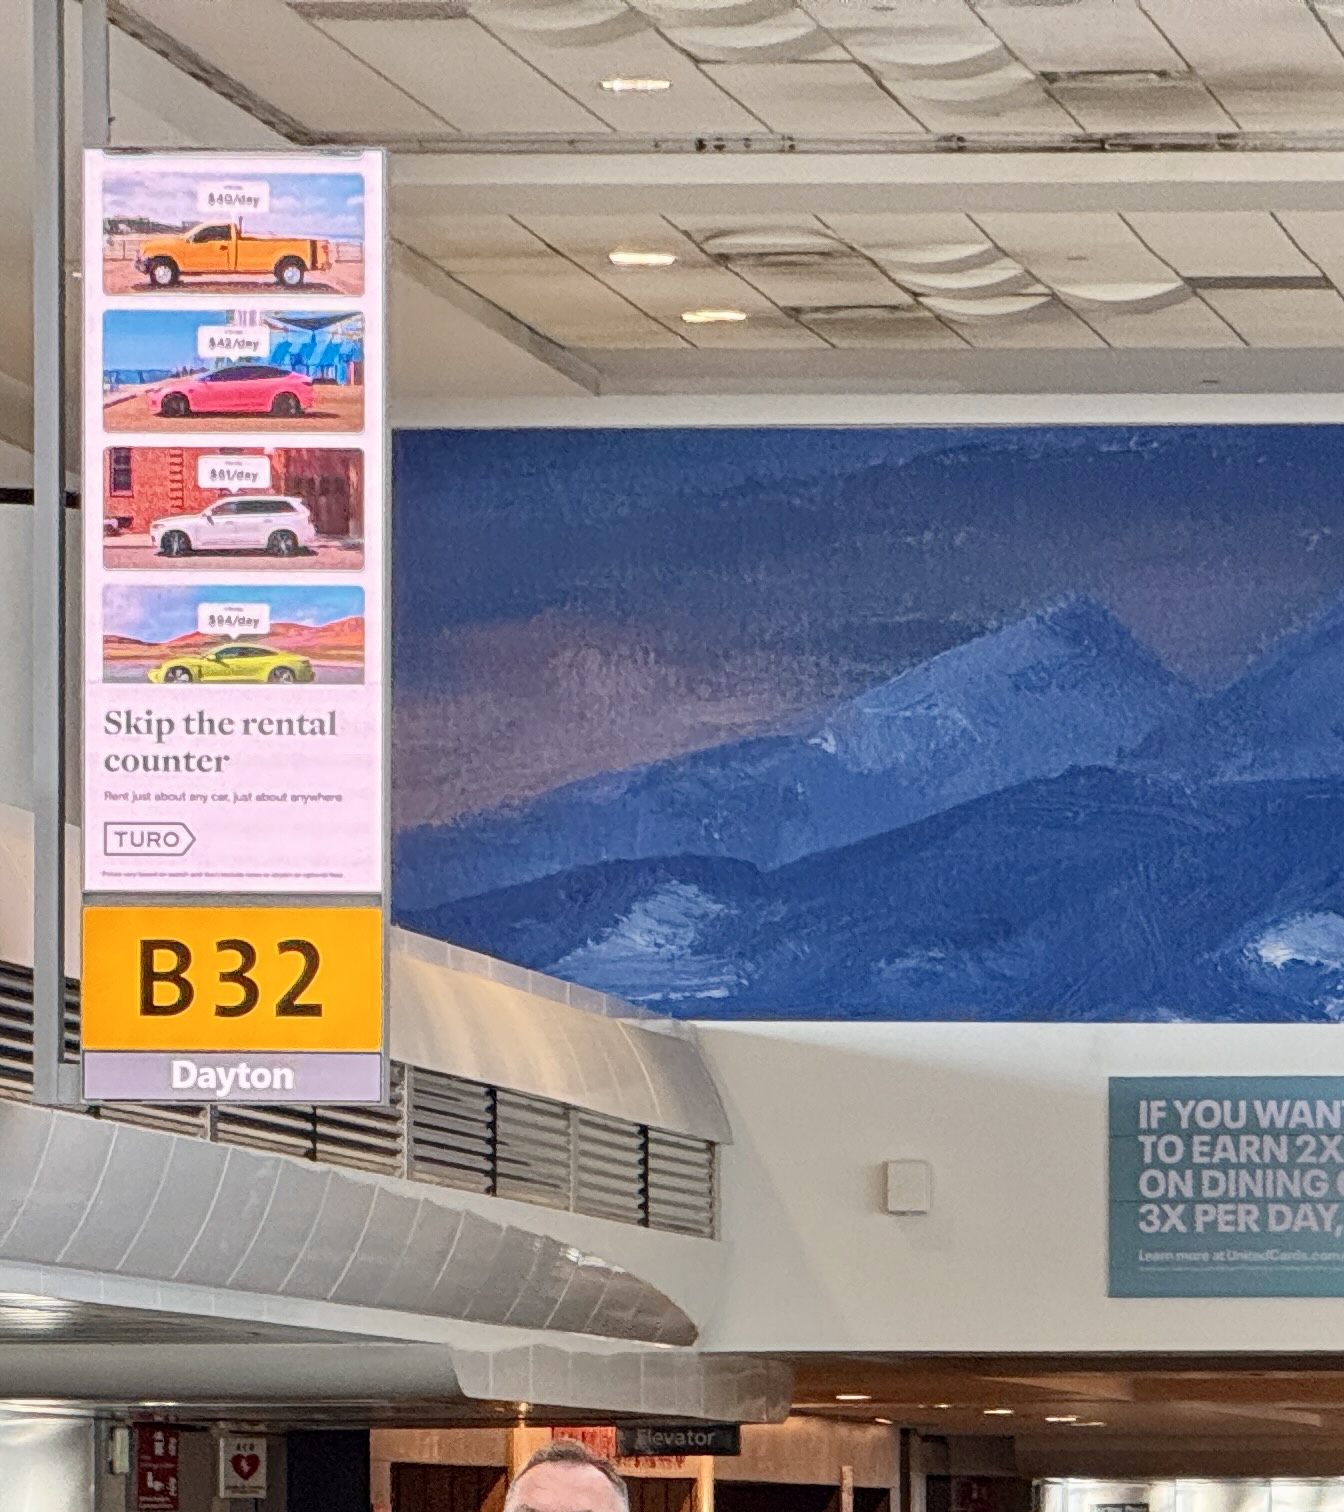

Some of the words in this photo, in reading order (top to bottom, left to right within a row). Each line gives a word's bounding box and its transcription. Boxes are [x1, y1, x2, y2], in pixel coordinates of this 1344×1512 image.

[104, 709, 175, 744] Skip
[183, 709, 234, 736] the
[242, 709, 338, 736] rental
[104, 751, 231, 773] counter
[104, 791, 129, 801] Rent
[131, 791, 151, 804] just
[155, 791, 186, 801] about
[190, 793, 208, 804] any
[233, 791, 252, 804] just
[256, 792, 287, 802] about
[114, 830, 180, 848] TURO
[139, 938, 323, 1017] B32
[171, 1059, 294, 1097] Dayton
[1138, 1099, 1168, 1130] IF
[1172, 1099, 1247, 1130] YOU
[1138, 1134, 1185, 1164] TO
[1192, 1134, 1289, 1164] EARN
[1295, 1134, 1344, 1164] 2X
[1138, 1168, 1194, 1199] ON
[1201, 1168, 1330, 1199] DINING
[1138, 1203, 1189, 1234] 3X
[1194, 1203, 1261, 1234] PER
[1267, 1203, 1344, 1238] DAY,
[636, 1429, 717, 1447] Elevator
